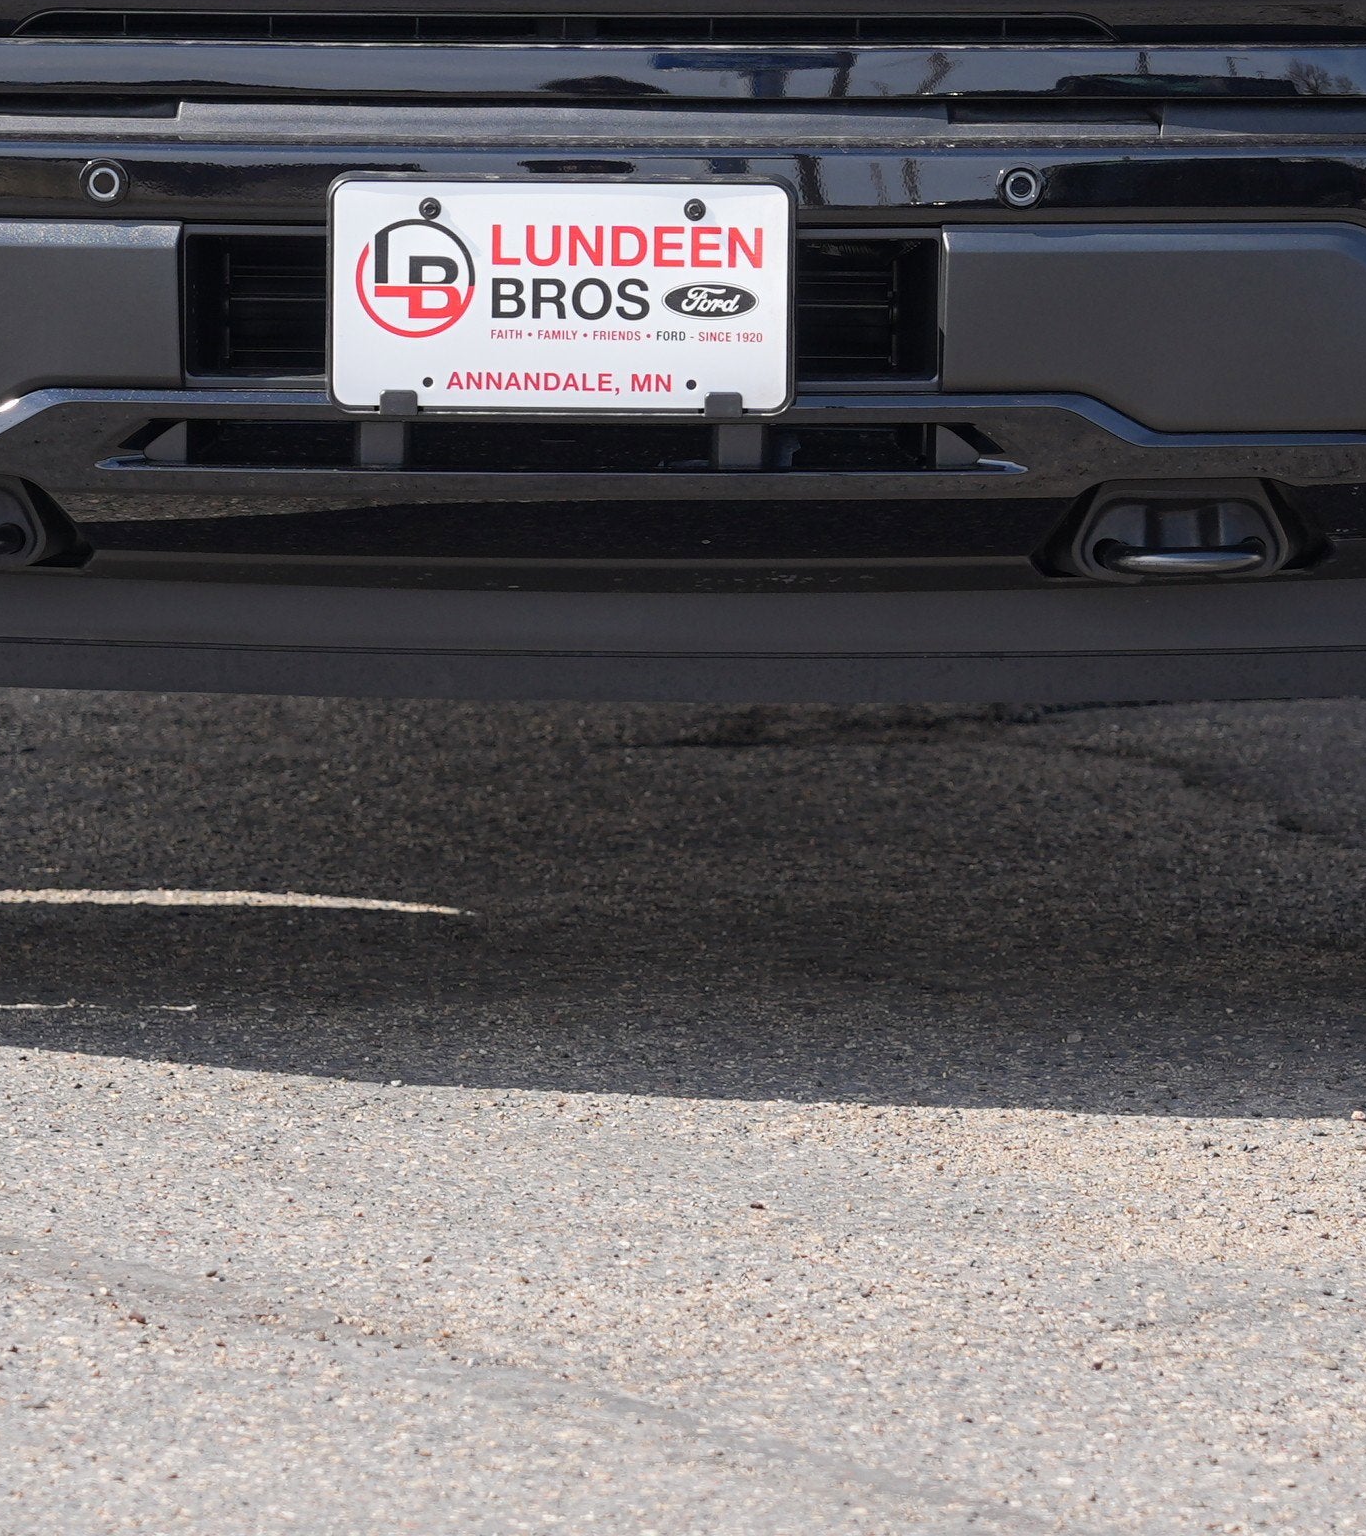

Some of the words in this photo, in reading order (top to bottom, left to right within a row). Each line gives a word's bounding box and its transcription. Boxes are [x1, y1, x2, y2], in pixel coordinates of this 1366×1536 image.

[492, 224, 763, 268] LUNDEEN
[491, 277, 650, 321] BROS
[681, 286, 741, 313] Ford
[490, 329, 523, 340] FAITH
[537, 329, 578, 341] FAMILY
[592, 330, 642, 341] FRIENDS
[656, 330, 686, 342] FORD
[698, 331, 732, 343] SINCE
[736, 332, 763, 343] 1920
[446, 370, 620, 395] ANNANDALE,
[631, 373, 672, 393] MN
